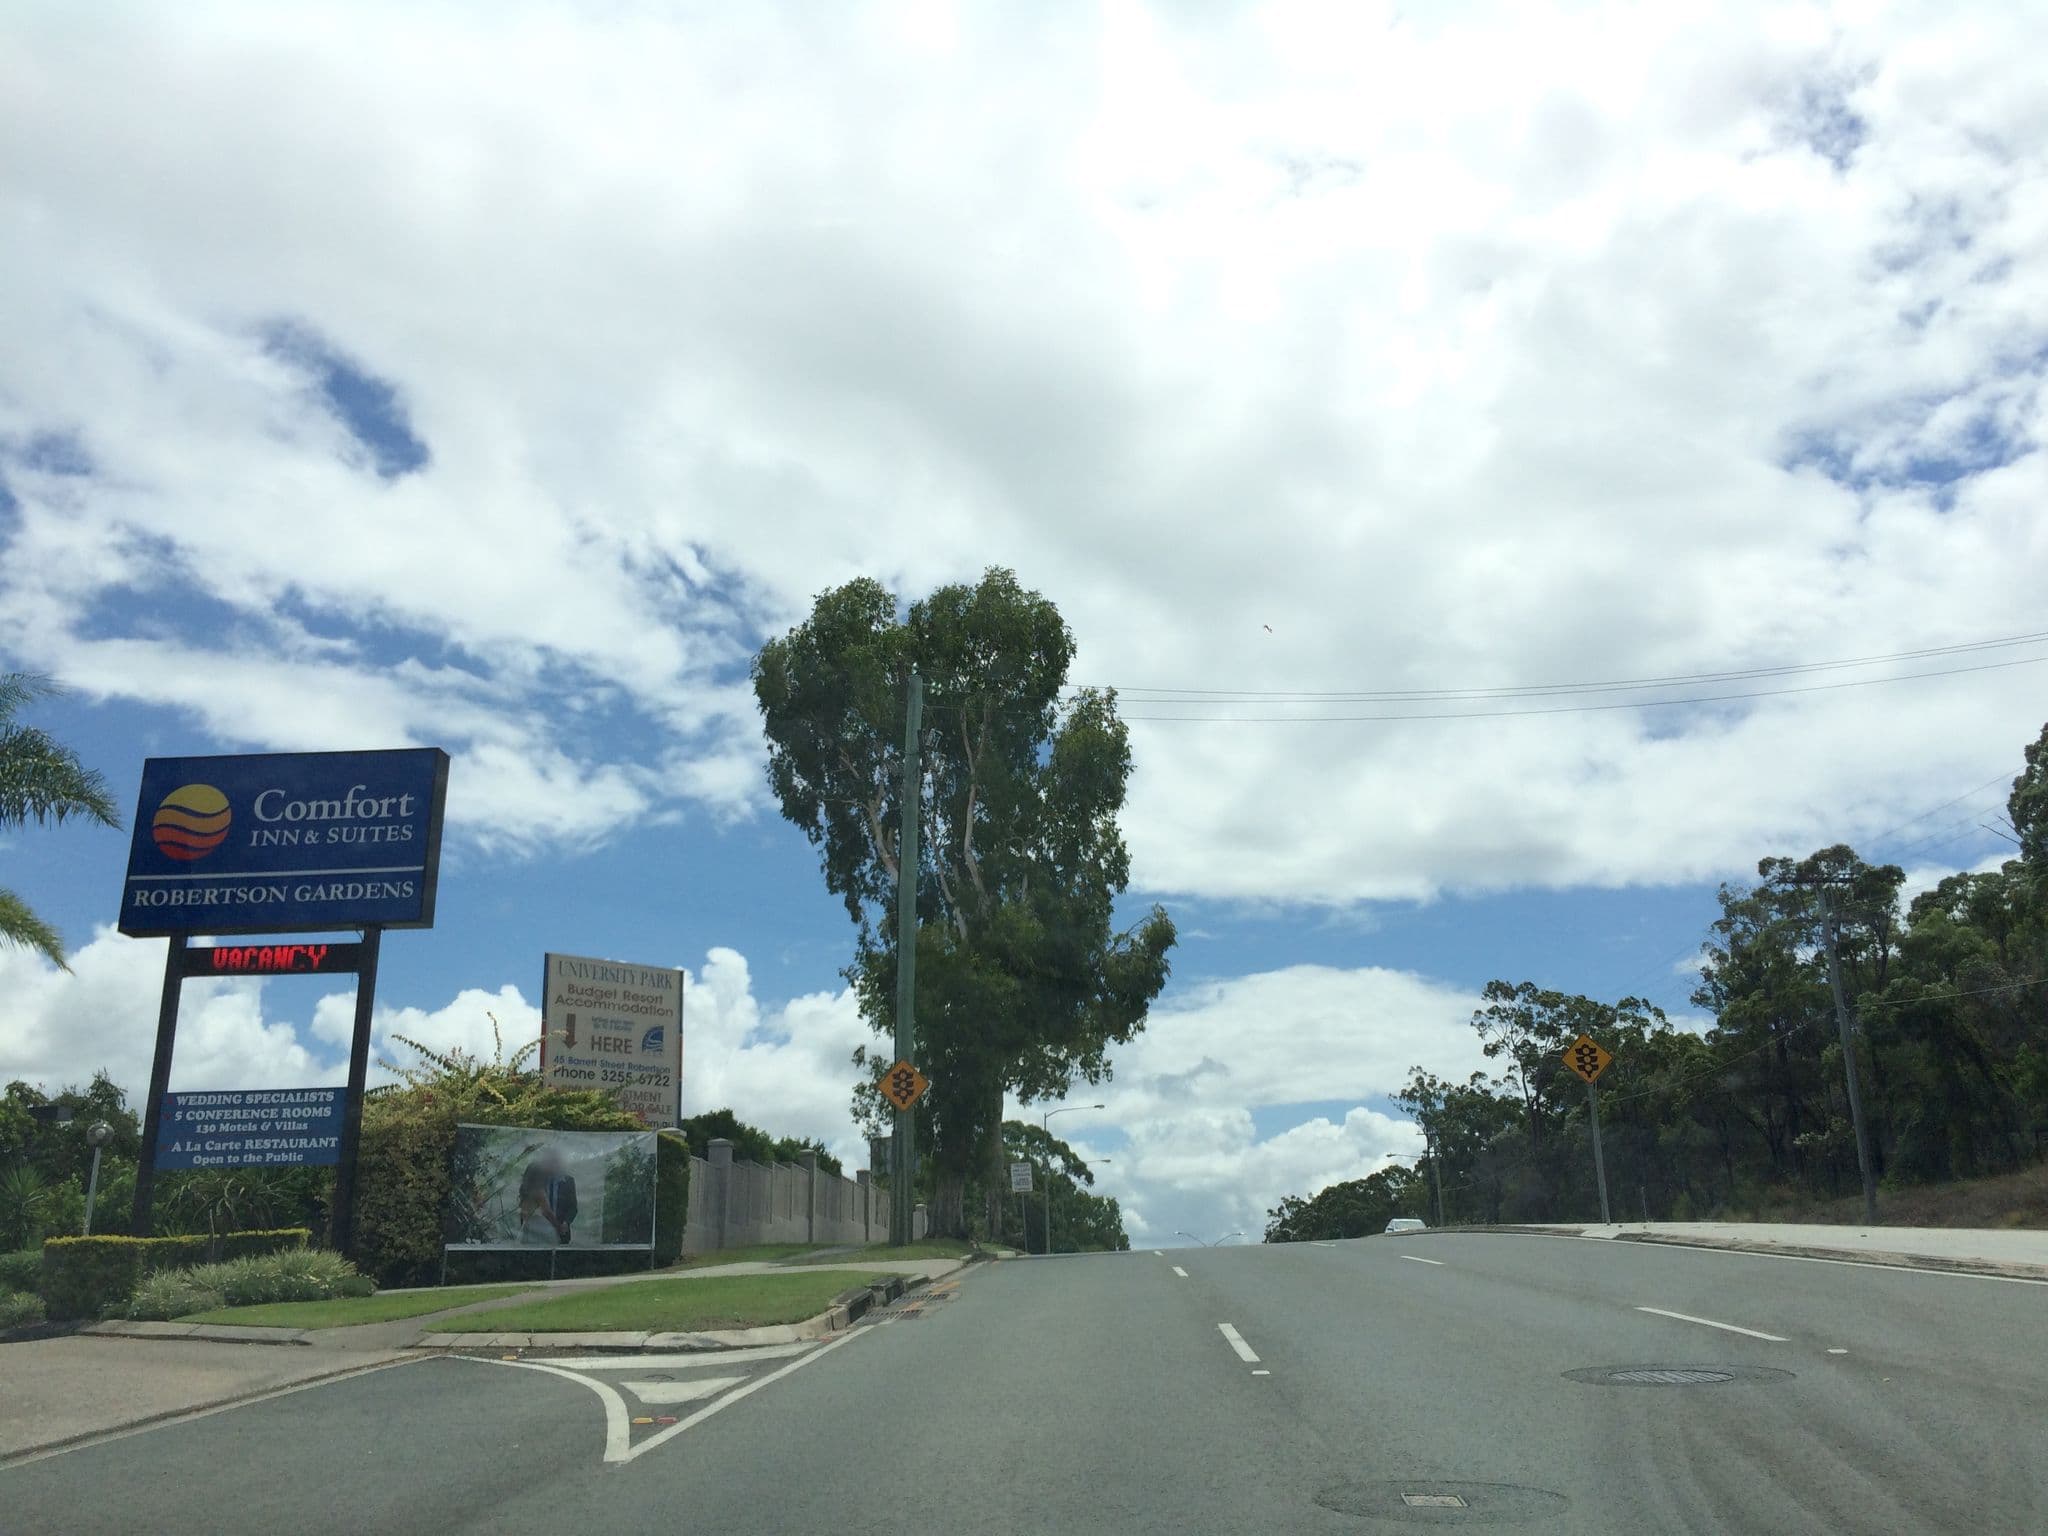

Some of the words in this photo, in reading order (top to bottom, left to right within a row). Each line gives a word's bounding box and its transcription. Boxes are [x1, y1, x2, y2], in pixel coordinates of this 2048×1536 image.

[254, 784, 414, 822] Comfort
[250, 829, 300, 847] INN
[304, 829, 319, 845] &
[326, 824, 414, 843] SUITES
[133, 885, 288, 907] ROBERTSON
[294, 880, 415, 902] GARDENS
[213, 944, 327, 970] VACANCY
[559, 960, 637, 986] UNIVERSITY
[641, 971, 673, 990] PARK
[567, 983, 617, 1001] Budget
[623, 990, 663, 1005] Resort
[554, 994, 674, 1017] Accommodation
[591, 1035, 633, 1054] HERE
[568, 1056, 598, 1067] Barrett
[599, 1059, 625, 1071] Street
[628, 1061, 671, 1074] Robertson
[553, 1066, 596, 1081] Phone
[601, 1070, 632, 1084] 3255
[638, 1074, 670, 1087] 6722
[176, 1093, 243, 1106] WEDDING
[245, 1091, 335, 1105] SPECIALISTS
[174, 1111, 183, 1121] 5
[186, 1108, 279, 1121] CONFERENCE
[282, 1106, 332, 1118] ROOMS
[196, 1124, 217, 1134] 130
[219, 1121, 258, 1133] Motels
[260, 1121, 271, 1131] &
[274, 1120, 308, 1131] Villas
[171, 1141, 182, 1152] A
[185, 1140, 201, 1152] La
[205, 1139, 241, 1151] Carte
[244, 1137, 339, 1150] RESTAURANT
[192, 1154, 224, 1166] Open
[227, 1154, 240, 1164] to
[243, 1153, 263, 1163] the
[265, 1152, 304, 1162] Public
